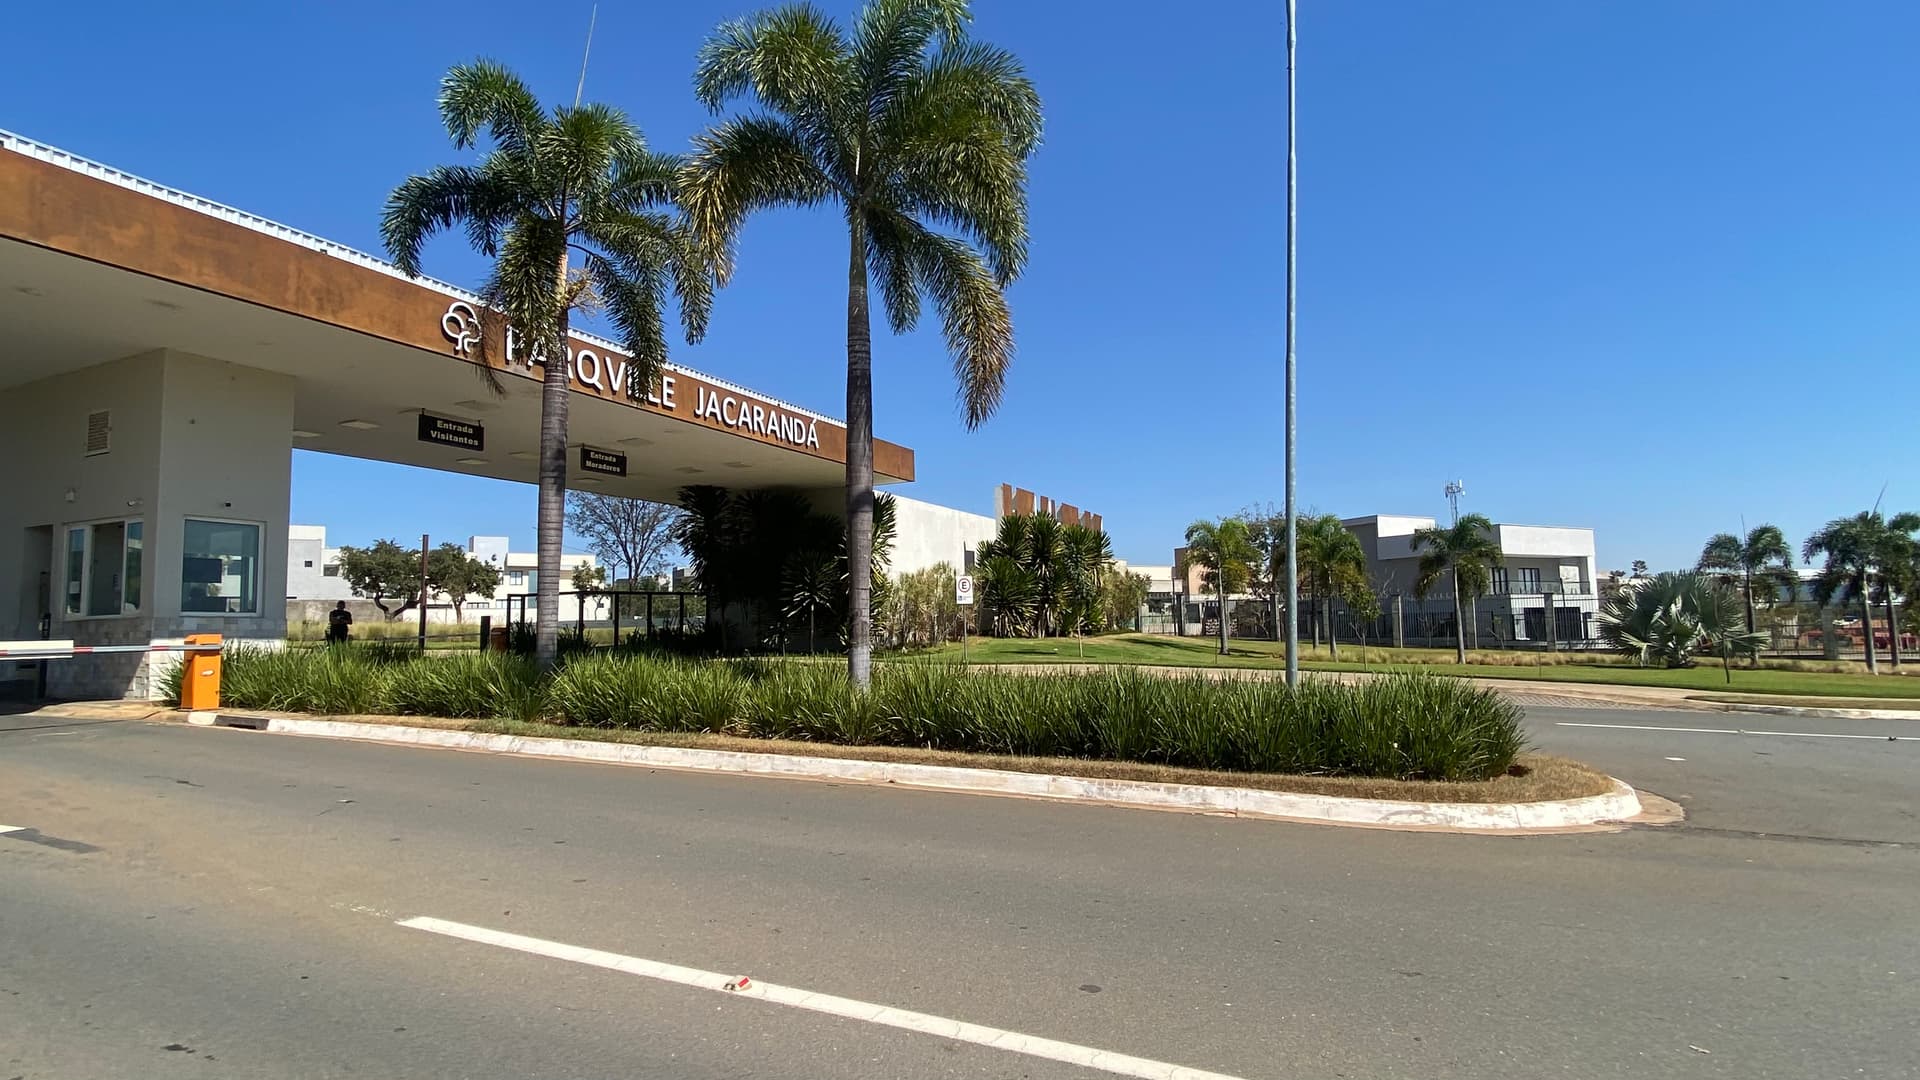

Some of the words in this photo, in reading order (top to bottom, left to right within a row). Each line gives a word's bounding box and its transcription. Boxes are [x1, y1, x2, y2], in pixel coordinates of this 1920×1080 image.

[694, 386, 819, 449] JACARANDÁ
[436, 420, 474, 434] Entrada
[430, 430, 479, 446] Visitantes
